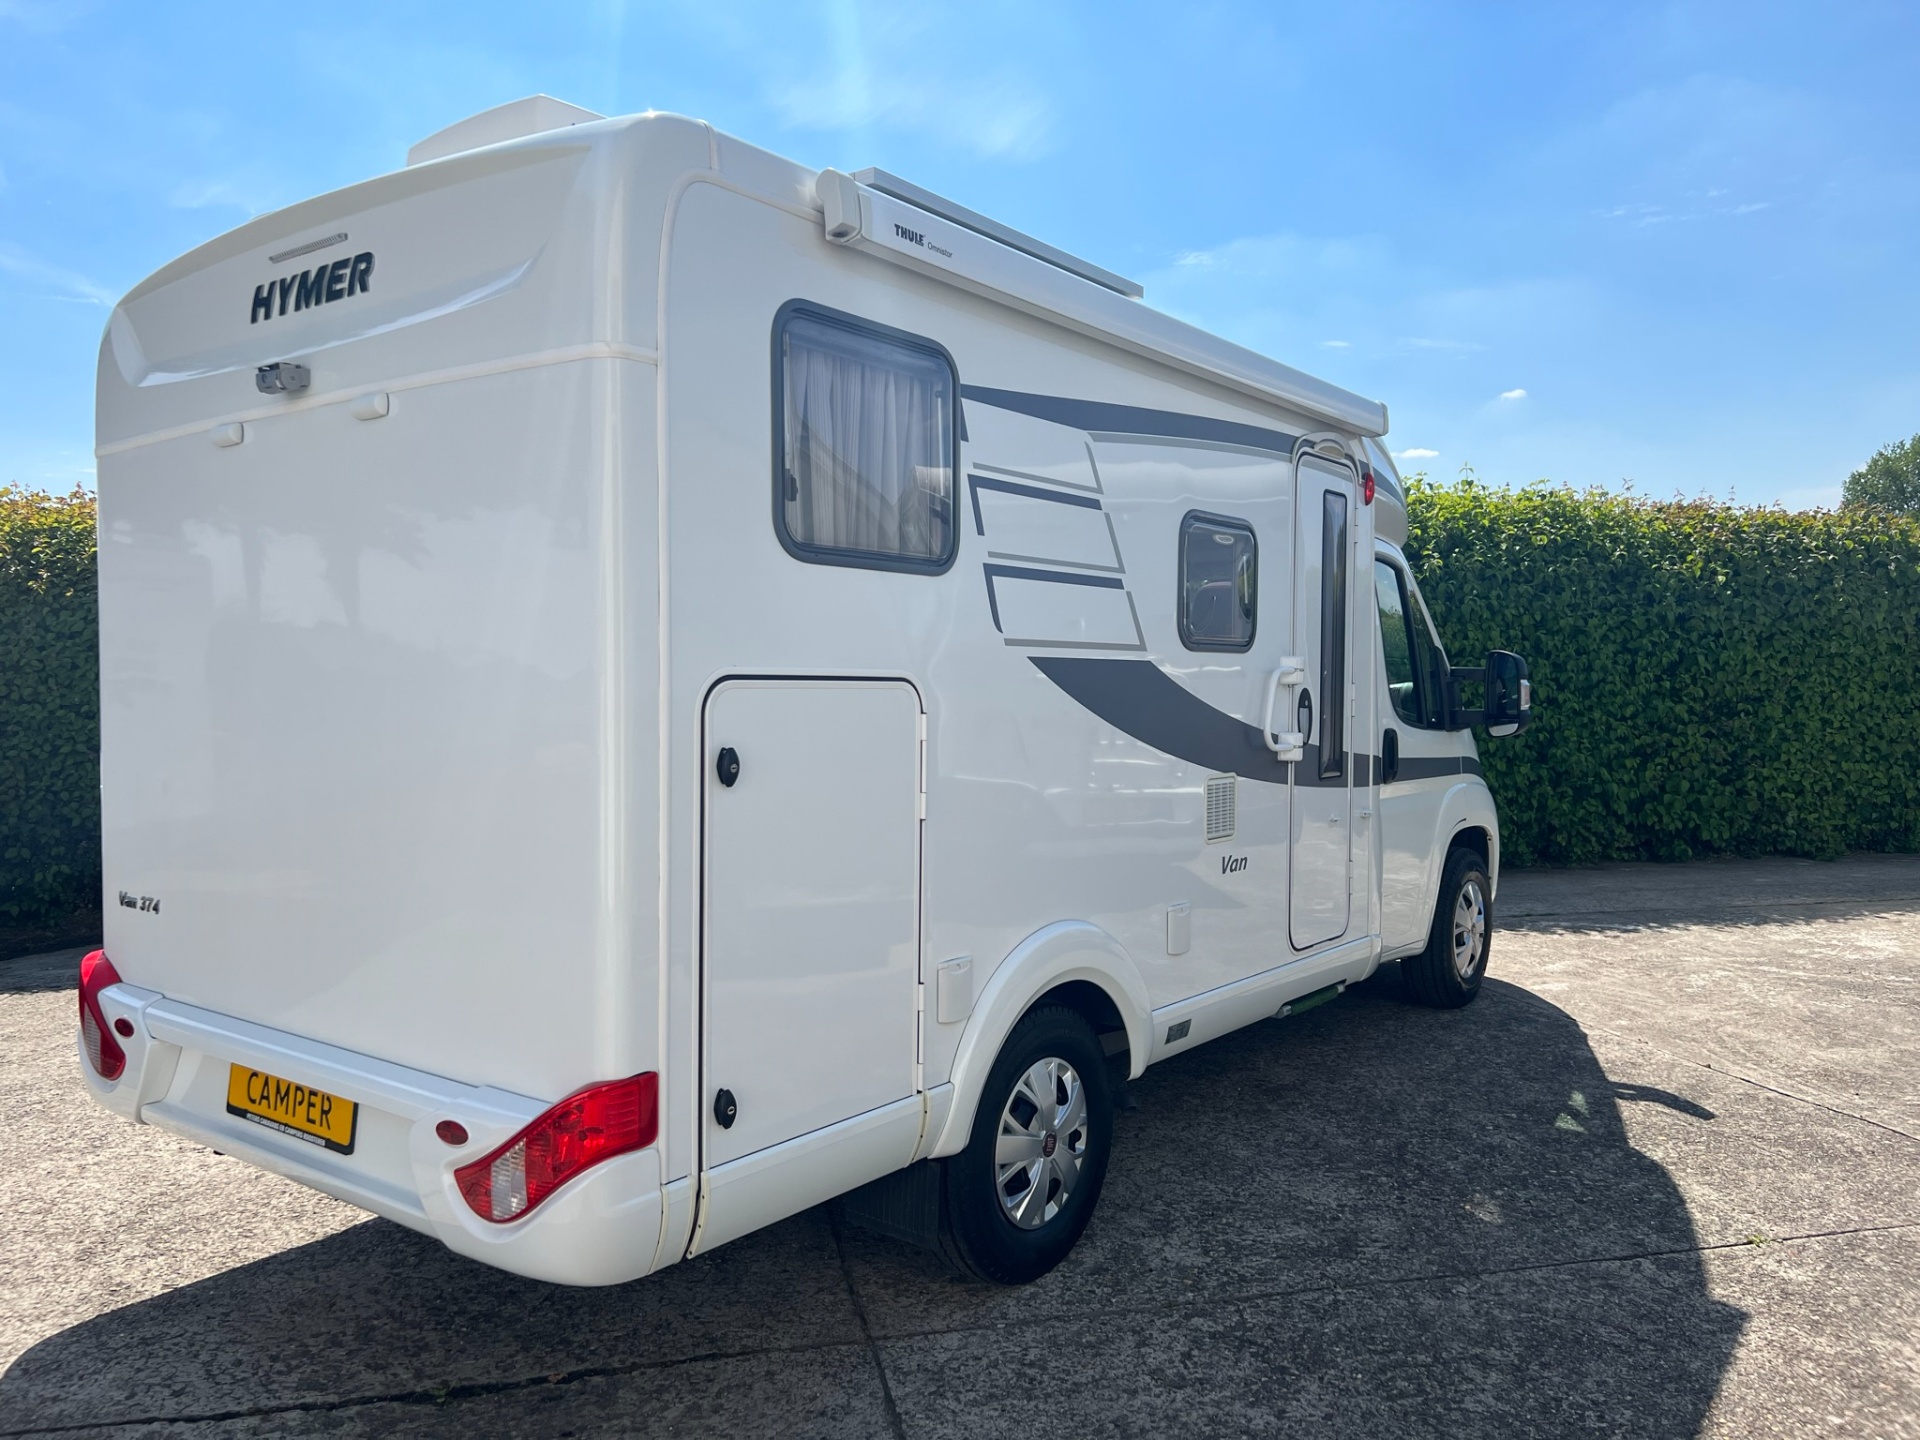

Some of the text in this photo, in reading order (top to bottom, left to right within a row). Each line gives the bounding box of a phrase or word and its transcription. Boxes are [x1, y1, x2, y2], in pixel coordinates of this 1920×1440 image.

[894, 223, 953, 258] THULE Omnistor
[250, 251, 375, 325] HYMER
[1222, 854, 1248, 875] Van
[119, 890, 161, 915] Van 374
[247, 1072, 332, 1130] CAMPER
[1046, 1137, 1054, 1151] FIAT
